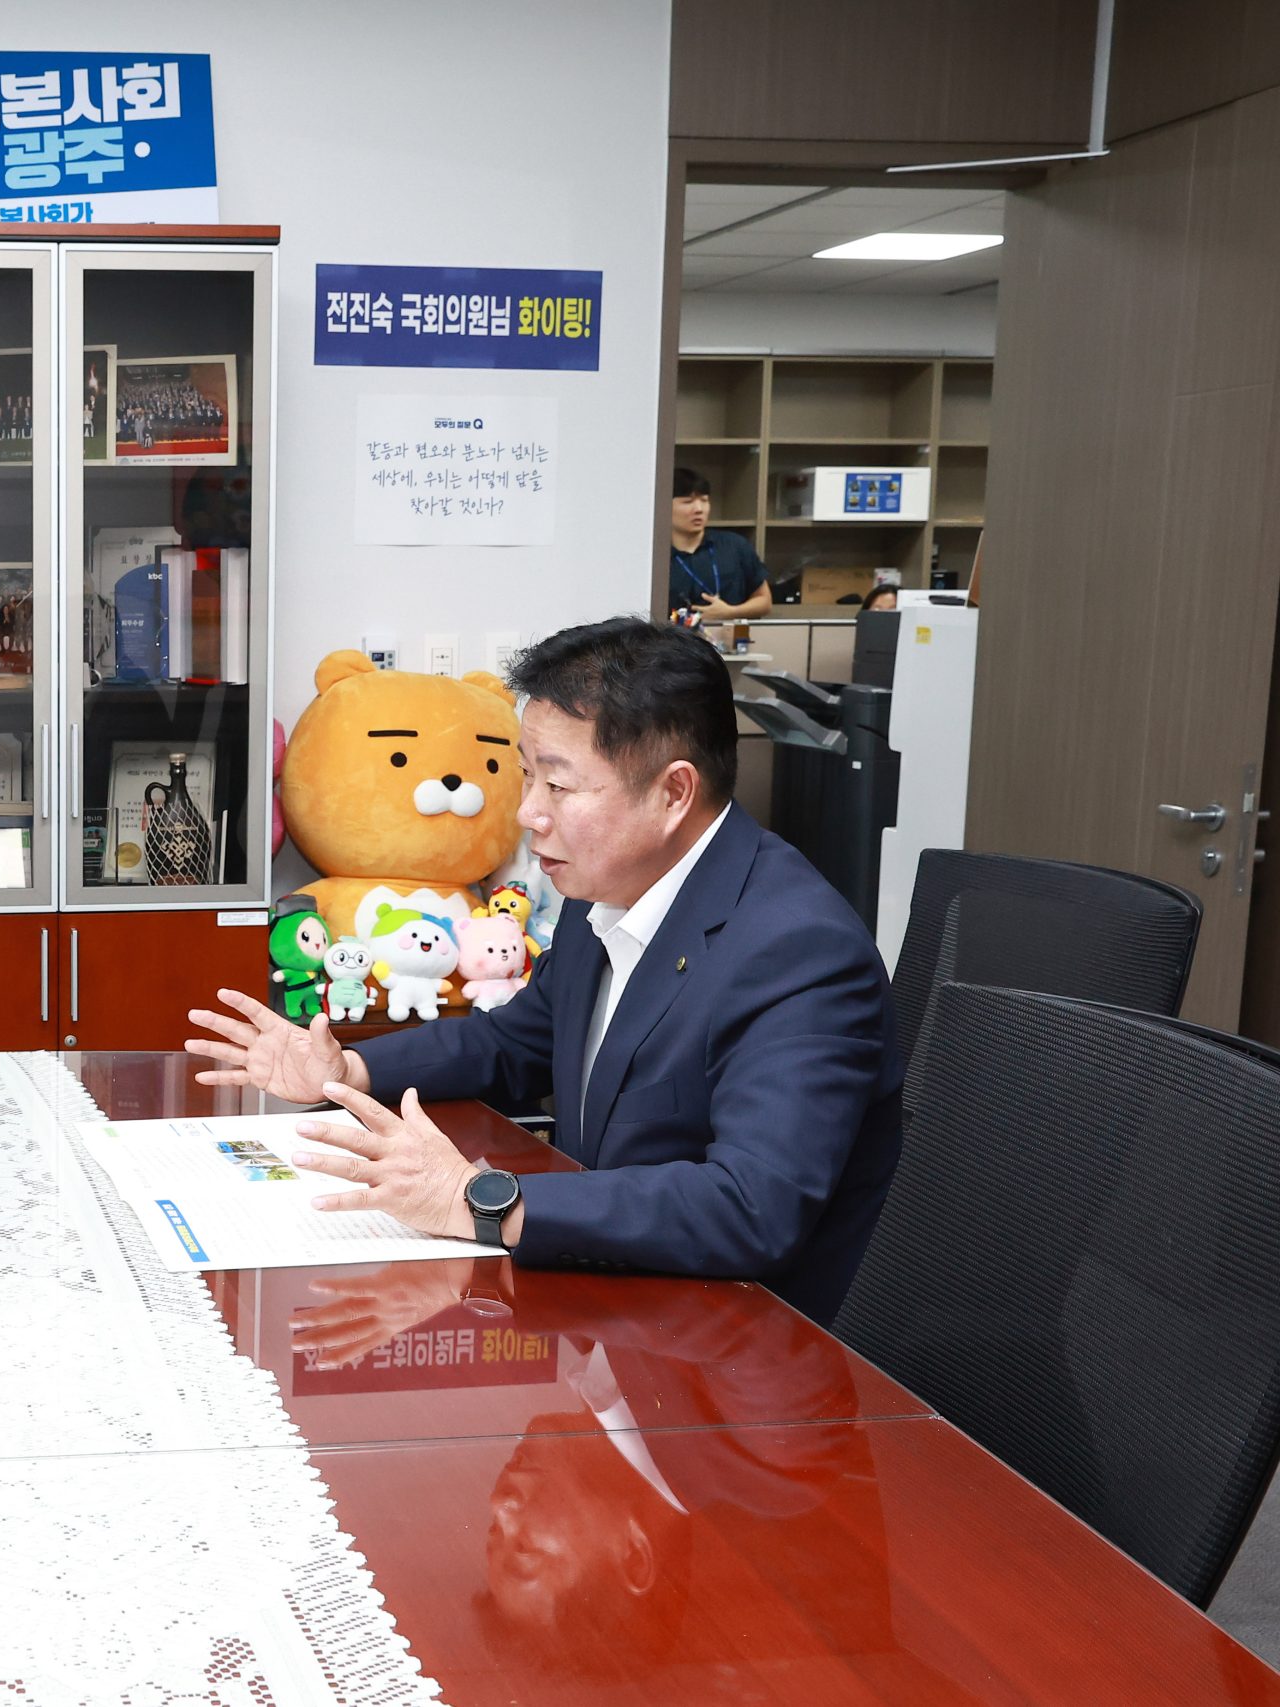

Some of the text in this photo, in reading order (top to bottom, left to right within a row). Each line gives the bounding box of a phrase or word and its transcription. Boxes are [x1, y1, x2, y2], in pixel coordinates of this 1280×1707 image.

[3, 126, 125, 190] 광주
[326, 291, 592, 339] 전진숙 국회의원님 화이팅!
[434, 420, 456, 429] 모두의
[473, 418, 483, 430] Q
[366, 441, 549, 463] 갈등과 혐오와 분노가 넘치는
[372, 469, 543, 492] 세상에, 우리는 어떻게 답을
[410, 497, 505, 517] 찾아갈 것인가?
